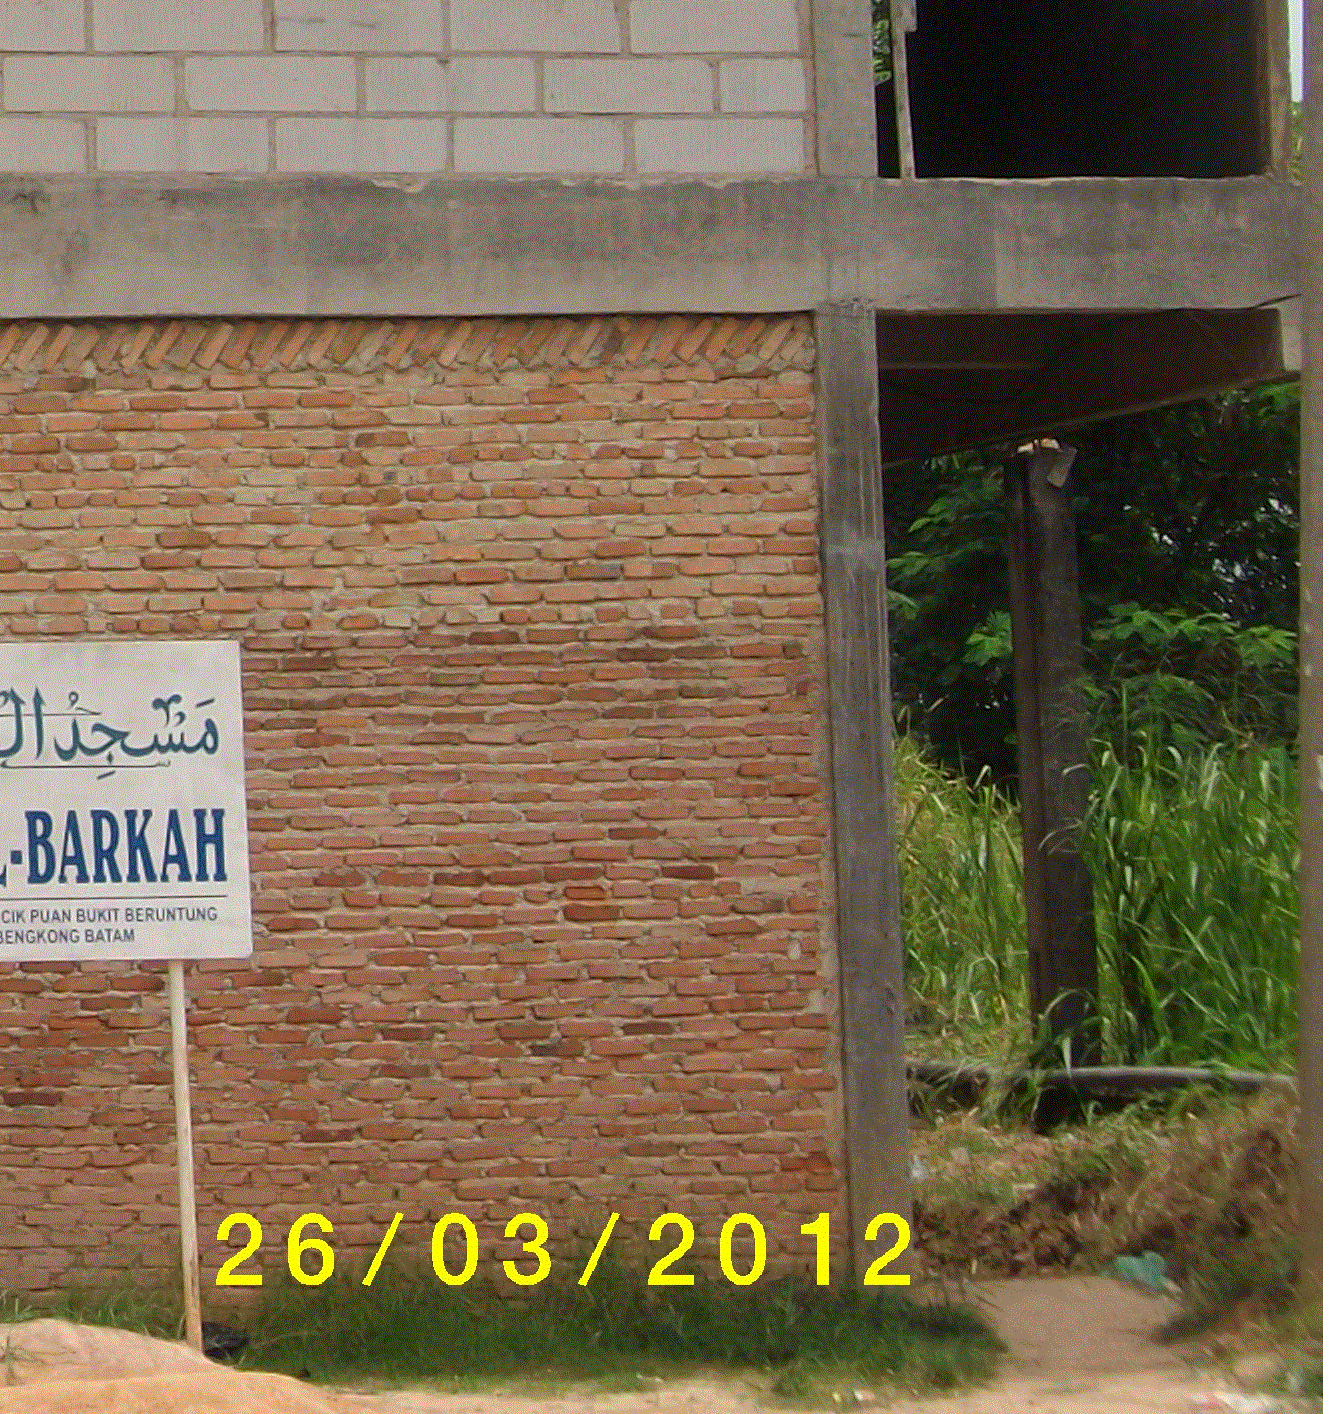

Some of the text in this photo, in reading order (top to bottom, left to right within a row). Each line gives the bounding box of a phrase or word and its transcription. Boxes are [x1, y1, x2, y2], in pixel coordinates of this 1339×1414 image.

[1, 909, 26, 923] CIK
[30, 909, 72, 923] PUAN
[76, 908, 120, 923] BUKIT
[125, 907, 218, 922] BERUNTUNG
[84, 928, 135, 942] BATAM
